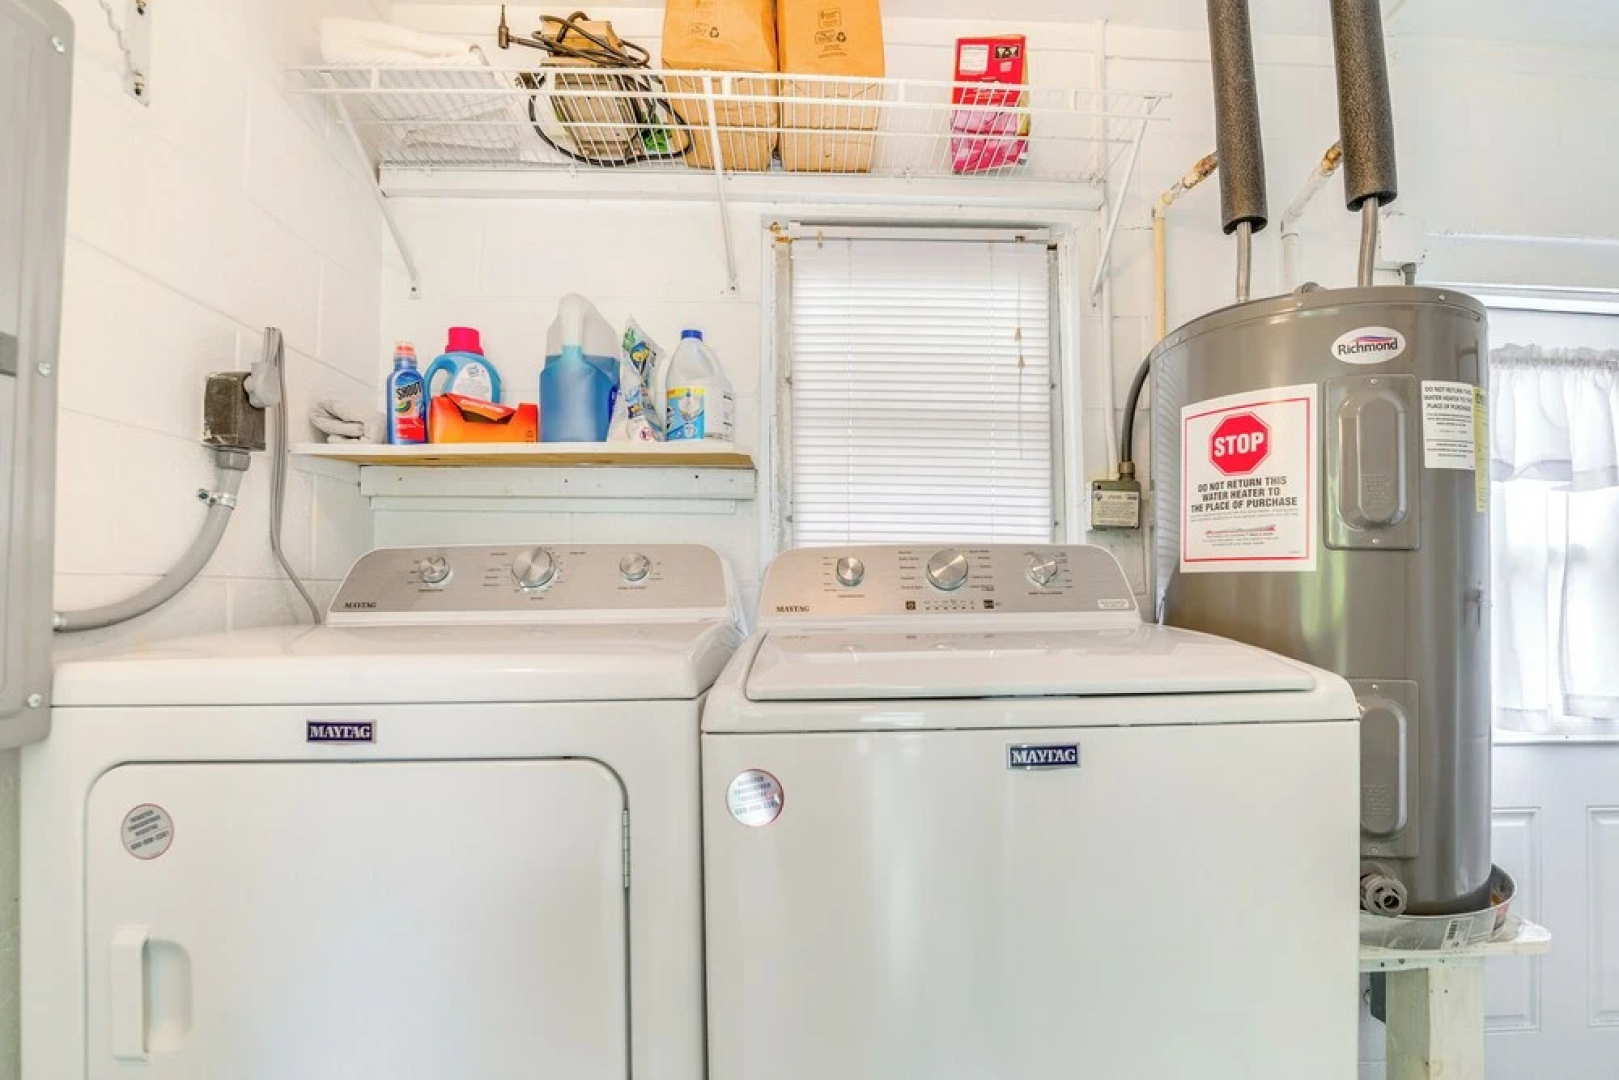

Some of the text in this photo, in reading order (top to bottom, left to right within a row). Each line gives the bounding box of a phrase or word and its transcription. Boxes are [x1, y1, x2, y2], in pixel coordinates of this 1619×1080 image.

[1338, 337, 1398, 355] Richmond
[1213, 431, 1264, 458] STOP
[1197, 476, 1287, 492] DO NOT RETURN THIS
[1202, 487, 1280, 502] WATER HEATER TO
[1191, 497, 1298, 513] THE PLACE OF PURCHASE
[310, 726, 371, 739] MAYTAG
[1011, 749, 1076, 764] MAYTAG
